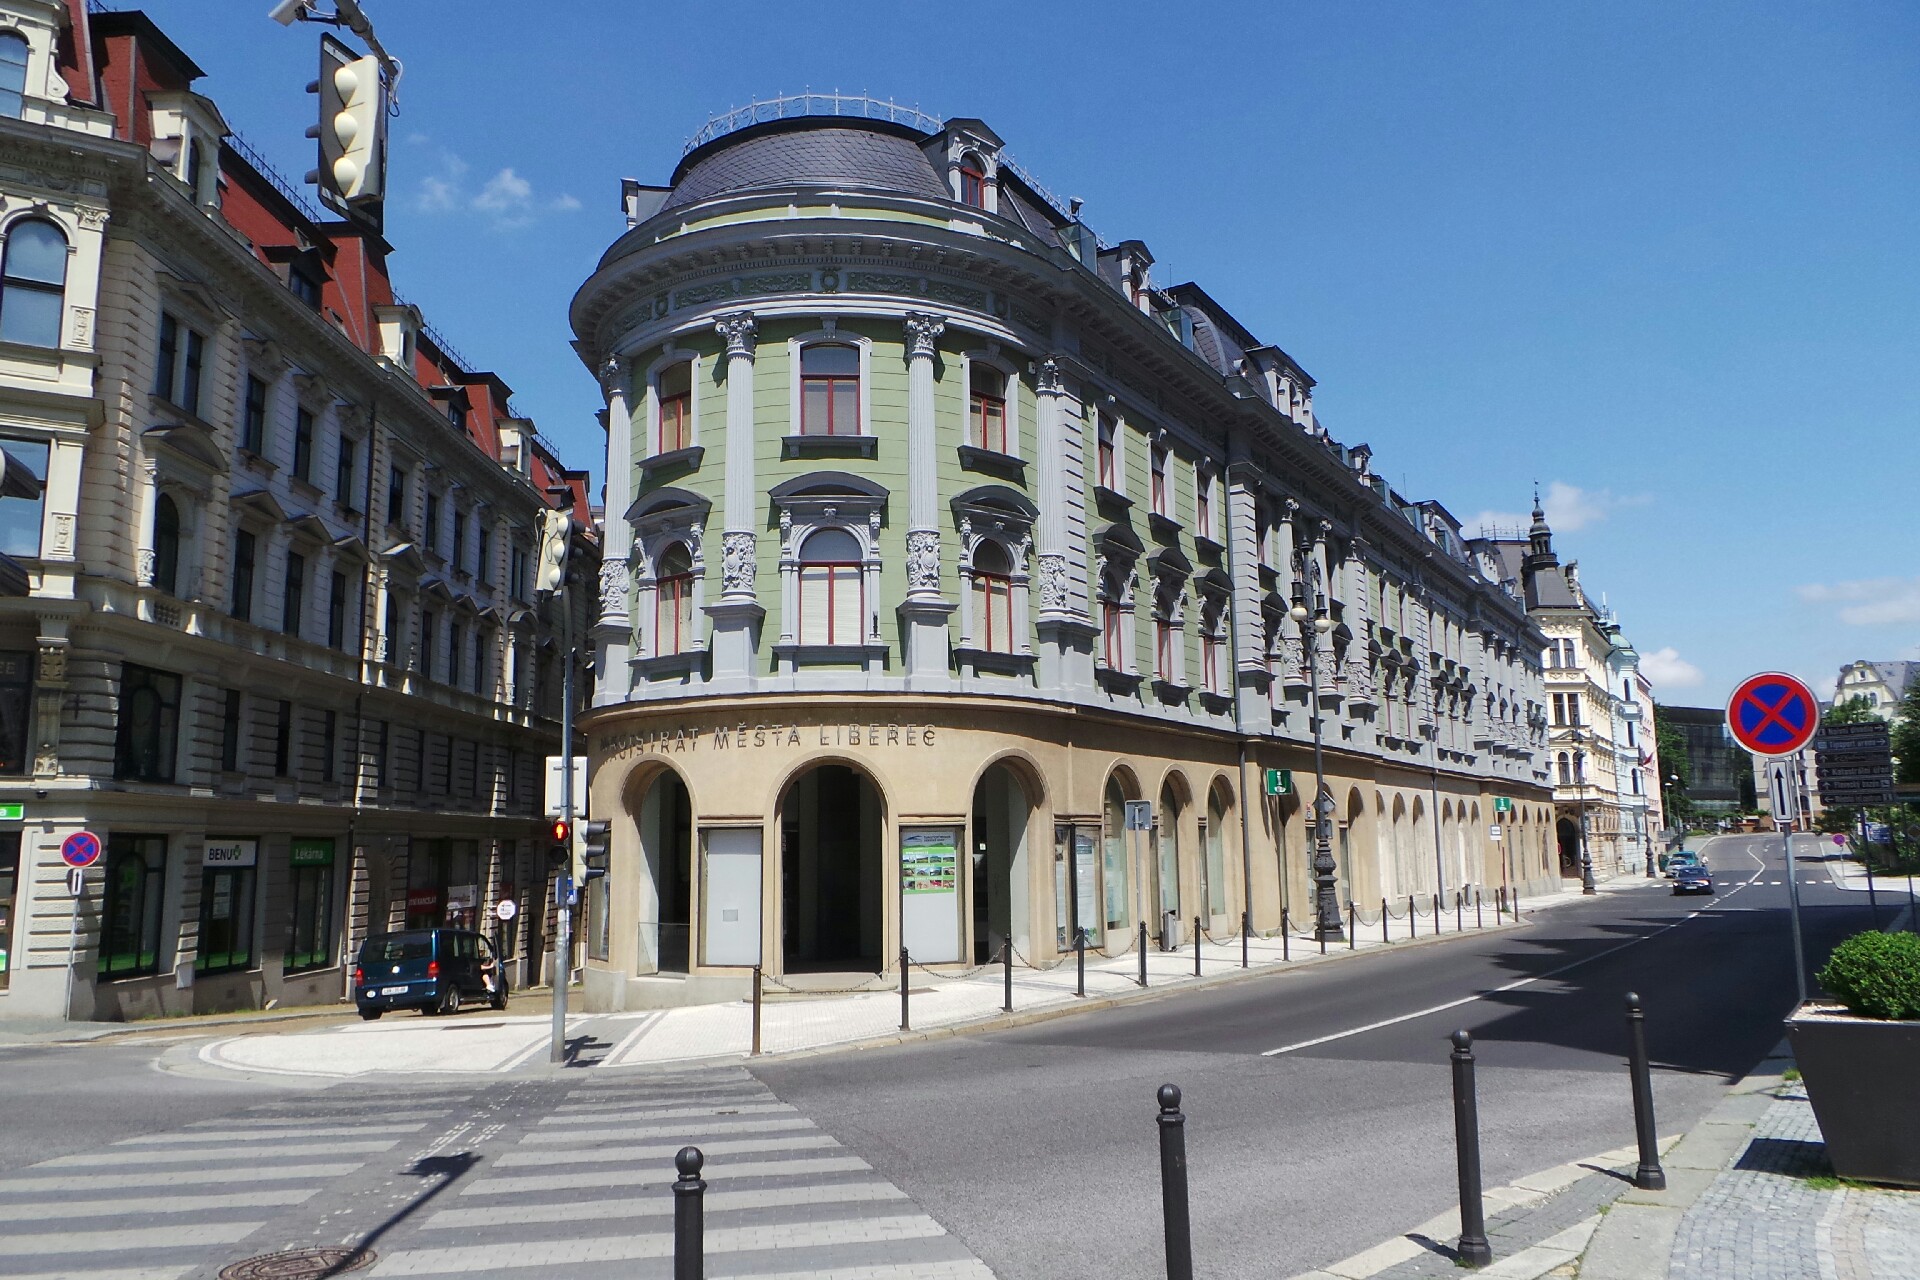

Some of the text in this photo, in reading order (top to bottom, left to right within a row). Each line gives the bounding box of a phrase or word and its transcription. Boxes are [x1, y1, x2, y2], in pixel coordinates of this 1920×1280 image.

[713, 721, 801, 749] MĚSTA
[819, 722, 936, 747] LIBEREC
[208, 848, 234, 860] BENU
[294, 847, 324, 860] Lékárna
